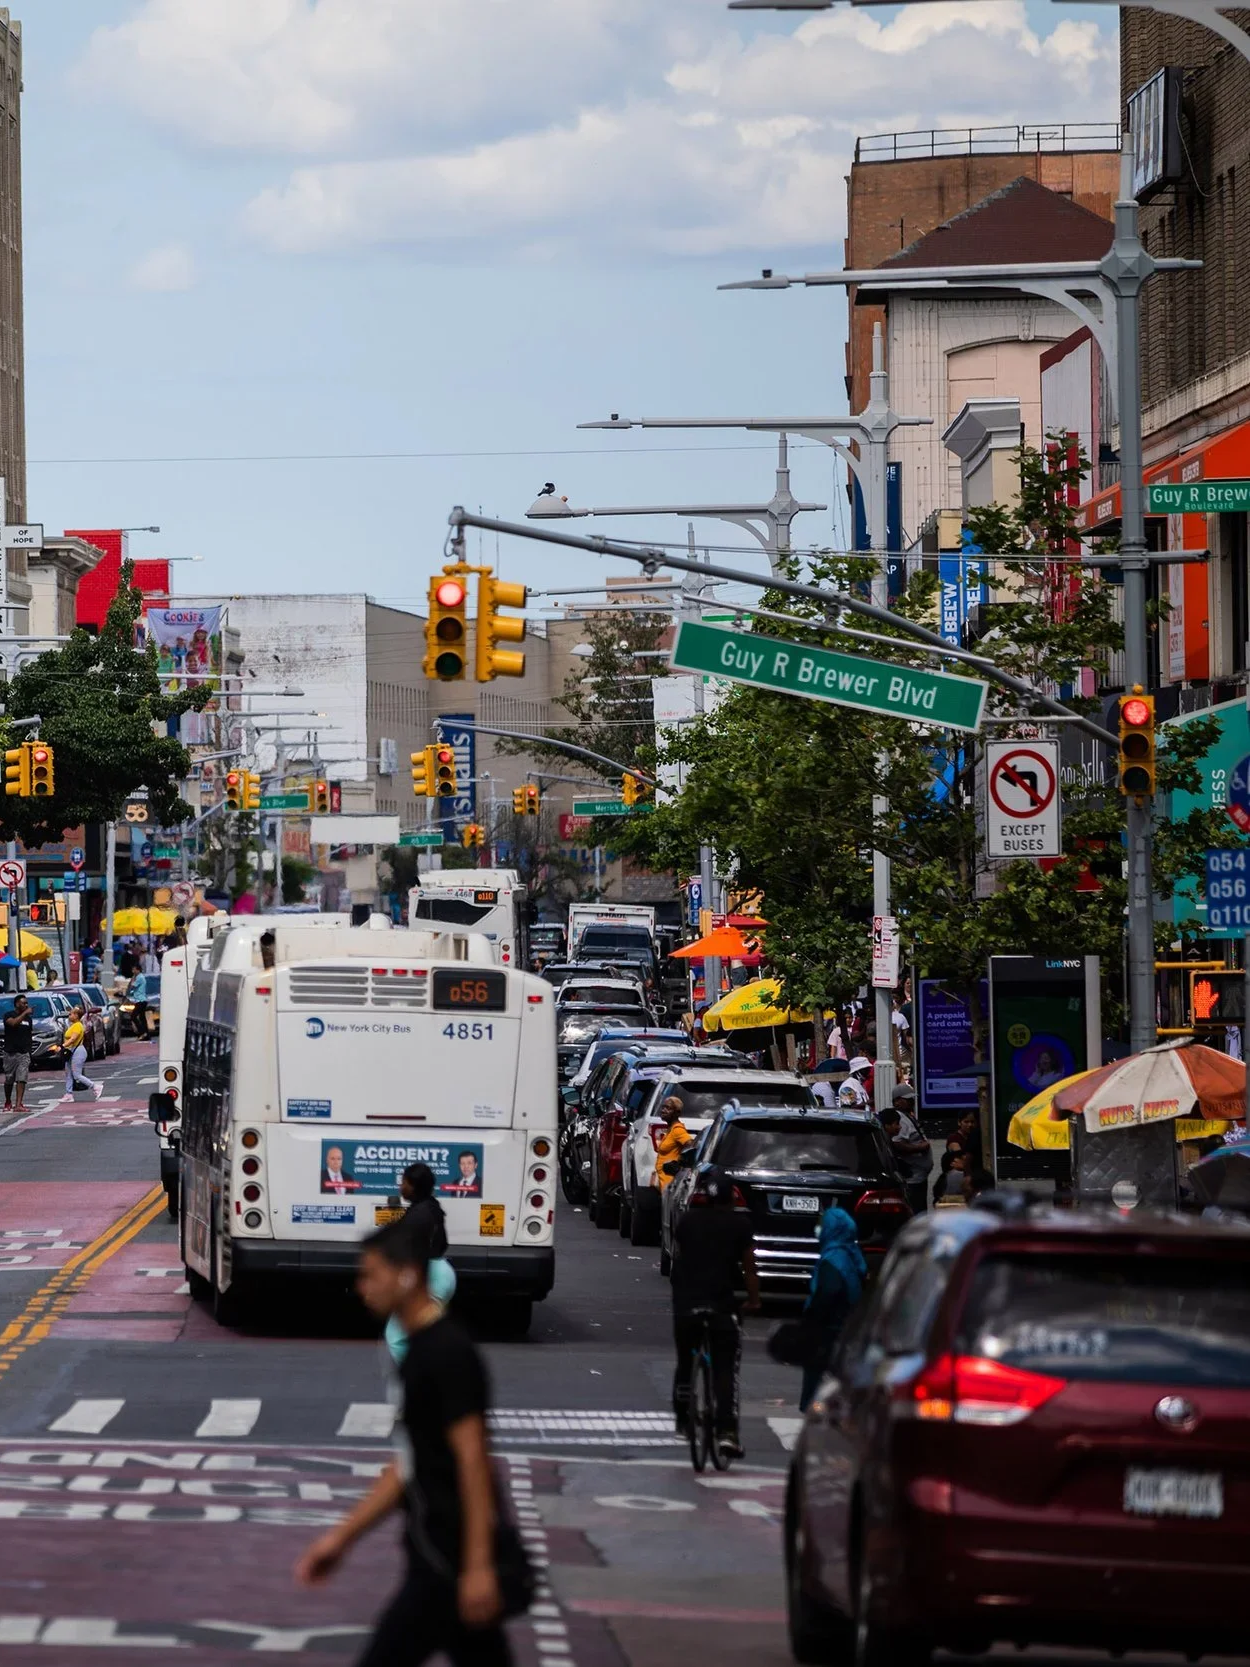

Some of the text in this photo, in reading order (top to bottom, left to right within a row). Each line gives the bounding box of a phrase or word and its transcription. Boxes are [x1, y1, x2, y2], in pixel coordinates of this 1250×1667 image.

[1152, 488, 1183, 507] Guy
[1190, 487, 1200, 502] R
[1184, 502, 1235, 511] Boulevard
[720, 641, 938, 710] Guy R Brewer Blvd
[1001, 824, 1047, 836] EXCEPT
[1003, 839, 1044, 851] BUSES
[1209, 852, 1246, 872] Q54
[1209, 878, 1246, 898] Q56
[1045, 960, 1081, 968] LinkNYC
[934, 1012, 966, 1020] prepaid
[962, 1019, 973, 1027] he
[327, 1024, 347, 1032] New
[350, 1024, 369, 1032] York
[372, 1025, 391, 1034] City
[393, 1025, 411, 1033] Bus
[442, 1023, 494, 1040] 4851
[1099, 1104, 1135, 1127] NUTS
[1143, 1099, 1180, 1120] NUTS
[354, 1145, 450, 1161] ACCIDENT?
